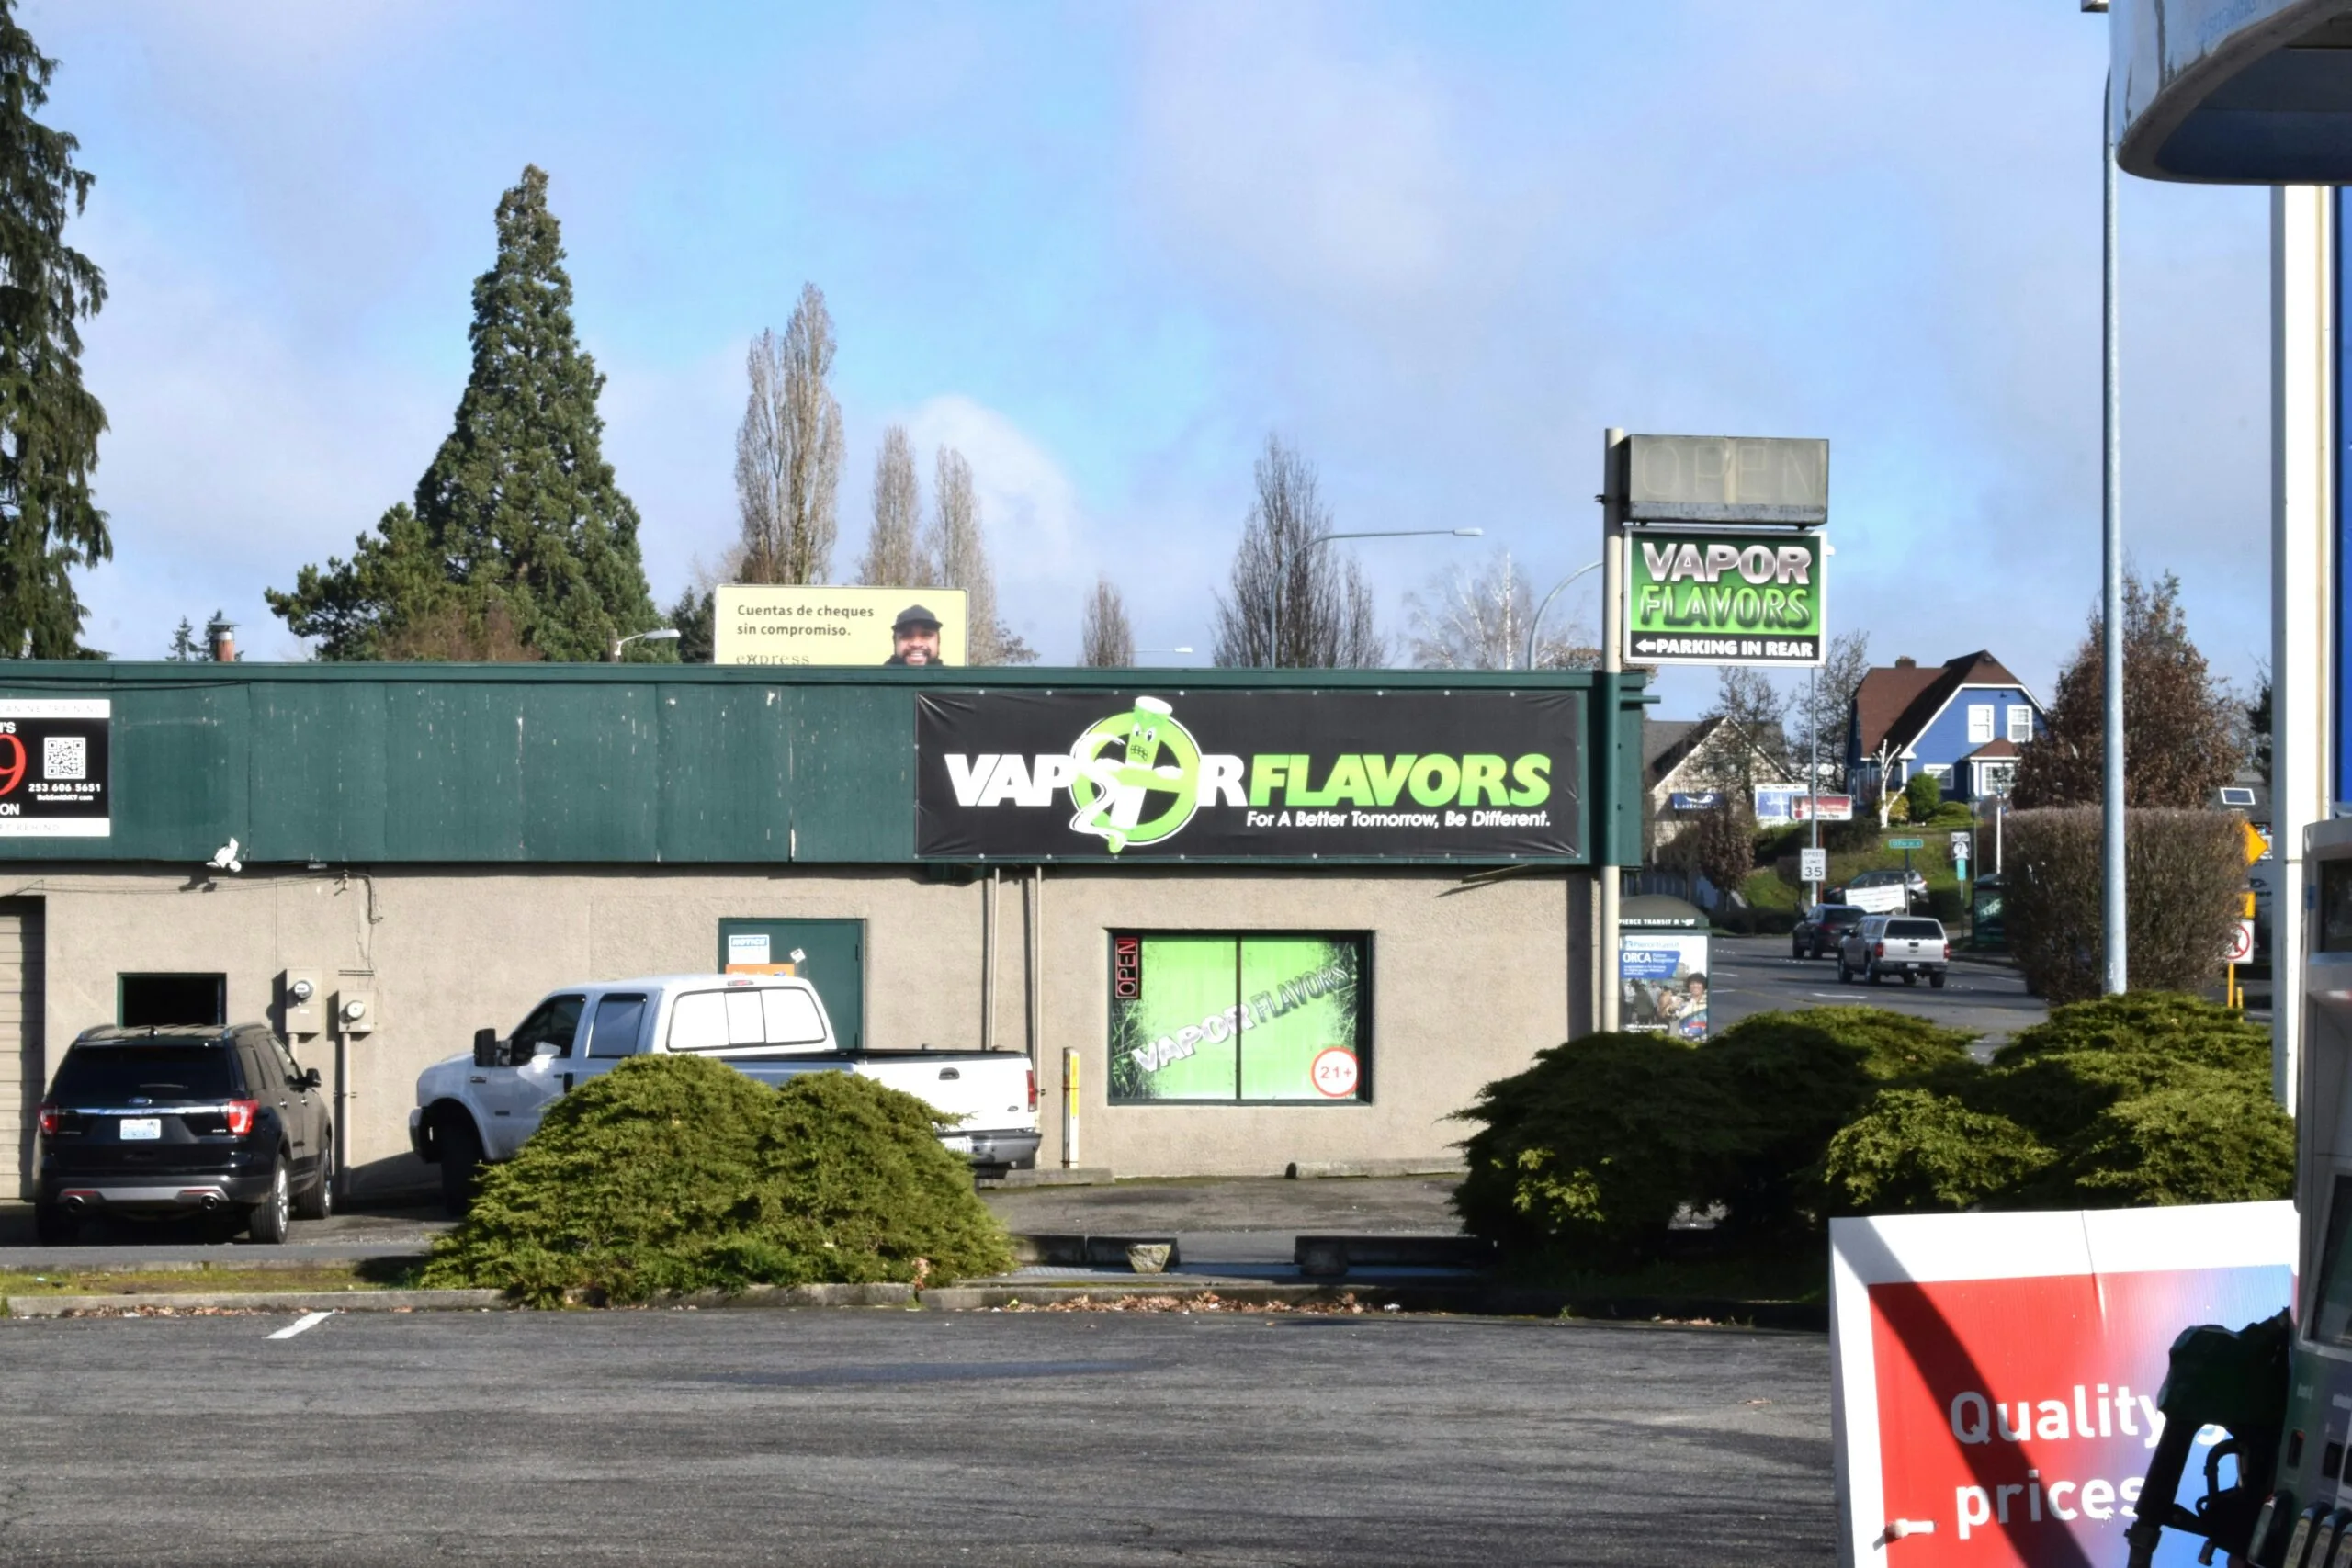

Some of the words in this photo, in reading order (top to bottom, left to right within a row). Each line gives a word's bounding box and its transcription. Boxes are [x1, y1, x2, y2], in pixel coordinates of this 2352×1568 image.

[1643, 443, 1817, 500] OPEN
[1642, 542, 1812, 584] VAPOR
[737, 604, 793, 616] Cuentas
[797, 604, 813, 616] de
[817, 605, 875, 619] cheques
[1640, 585, 1810, 629] FLAVORS
[737, 622, 757, 636] sin
[760, 624, 852, 637] compromiso.
[1657, 638, 1737, 656] PARKING
[1742, 641, 1763, 656] IN
[1766, 641, 1814, 657] REAR
[1249, 753, 1551, 807] FLAVORS
[1247, 810, 1274, 828] For
[1277, 811, 1291, 827] A
[1295, 810, 1347, 828] Better
[1351, 811, 1439, 829] Tomorrow,
[1445, 810, 1467, 827] Be
[1472, 810, 1551, 827] Different.
[1804, 866, 1824, 877] 35
[1118, 942, 1136, 996] OPEN
[1623, 952, 1651, 963] ORCA
[1131, 1002, 1256, 1073] VAPOR
[1250, 964, 1351, 1023] FLAVORS
[1320, 1066, 1352, 1078] 21+
[1951, 1383, 2166, 1449] Quality
[1956, 1469, 2148, 1540] prices
